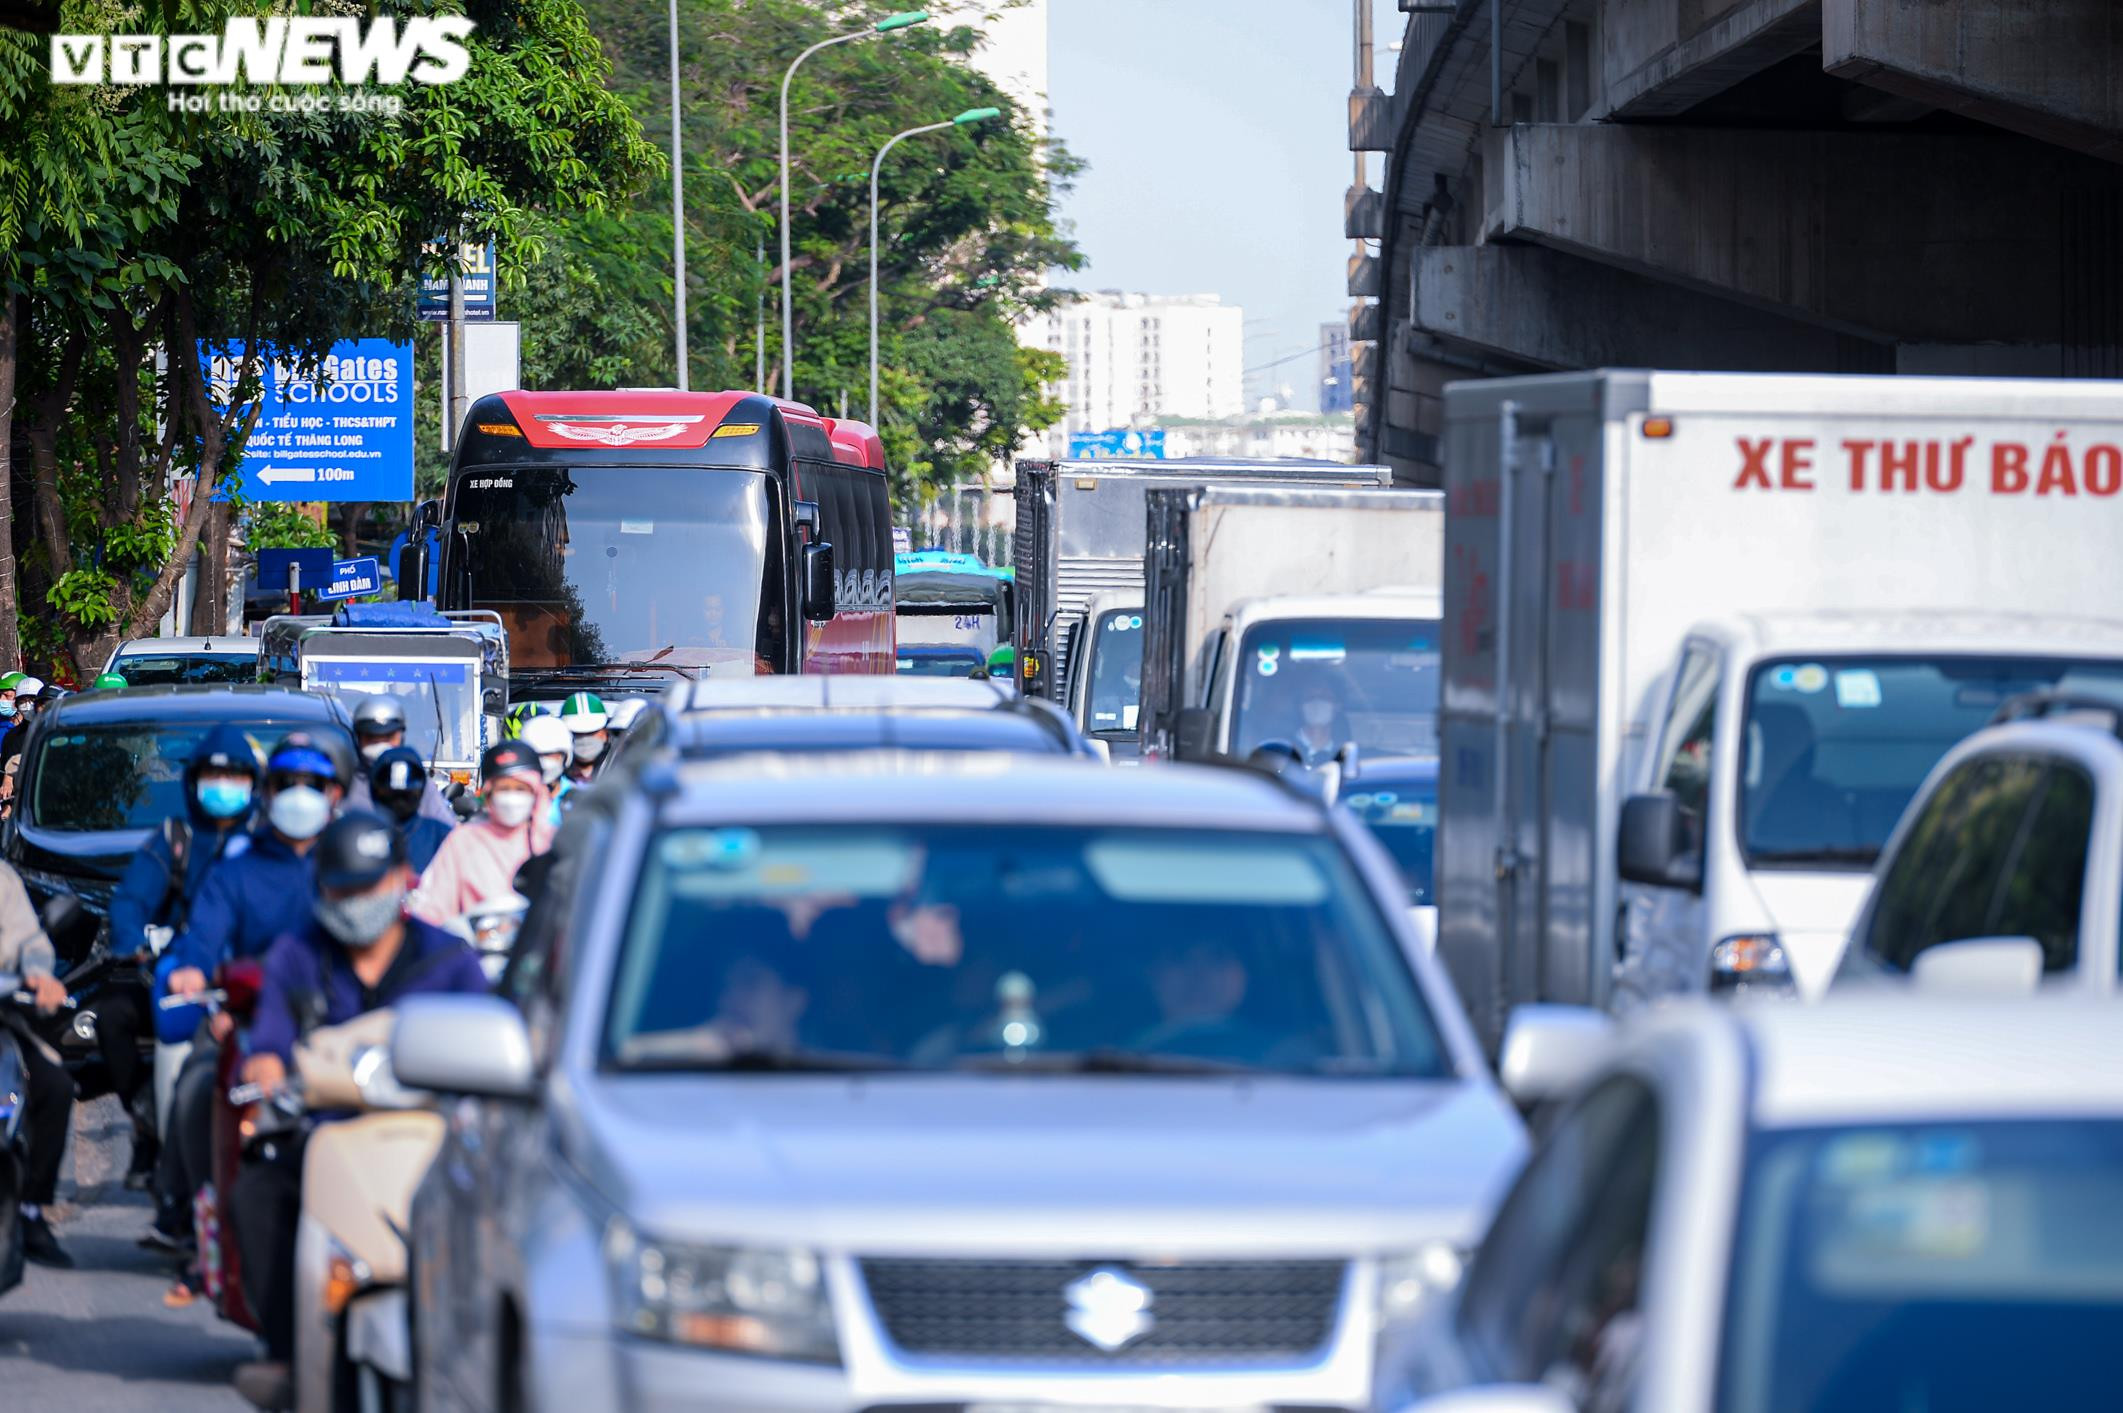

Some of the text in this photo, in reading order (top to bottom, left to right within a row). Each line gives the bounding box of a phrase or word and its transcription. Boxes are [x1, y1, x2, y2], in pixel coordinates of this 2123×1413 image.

[324, 354, 398, 381] Gates
[274, 383, 399, 403] SCHOOLS
[333, 416, 397, 428] THCS&THPT
[334, 434, 363, 446] LONG
[273, 450, 382, 460] billgatesschool.edu.vn
[1733, 430, 2123, 497] XE THƯ BÁO
[317, 467, 355, 482] 100m
[470, 479, 478, 489] XE
